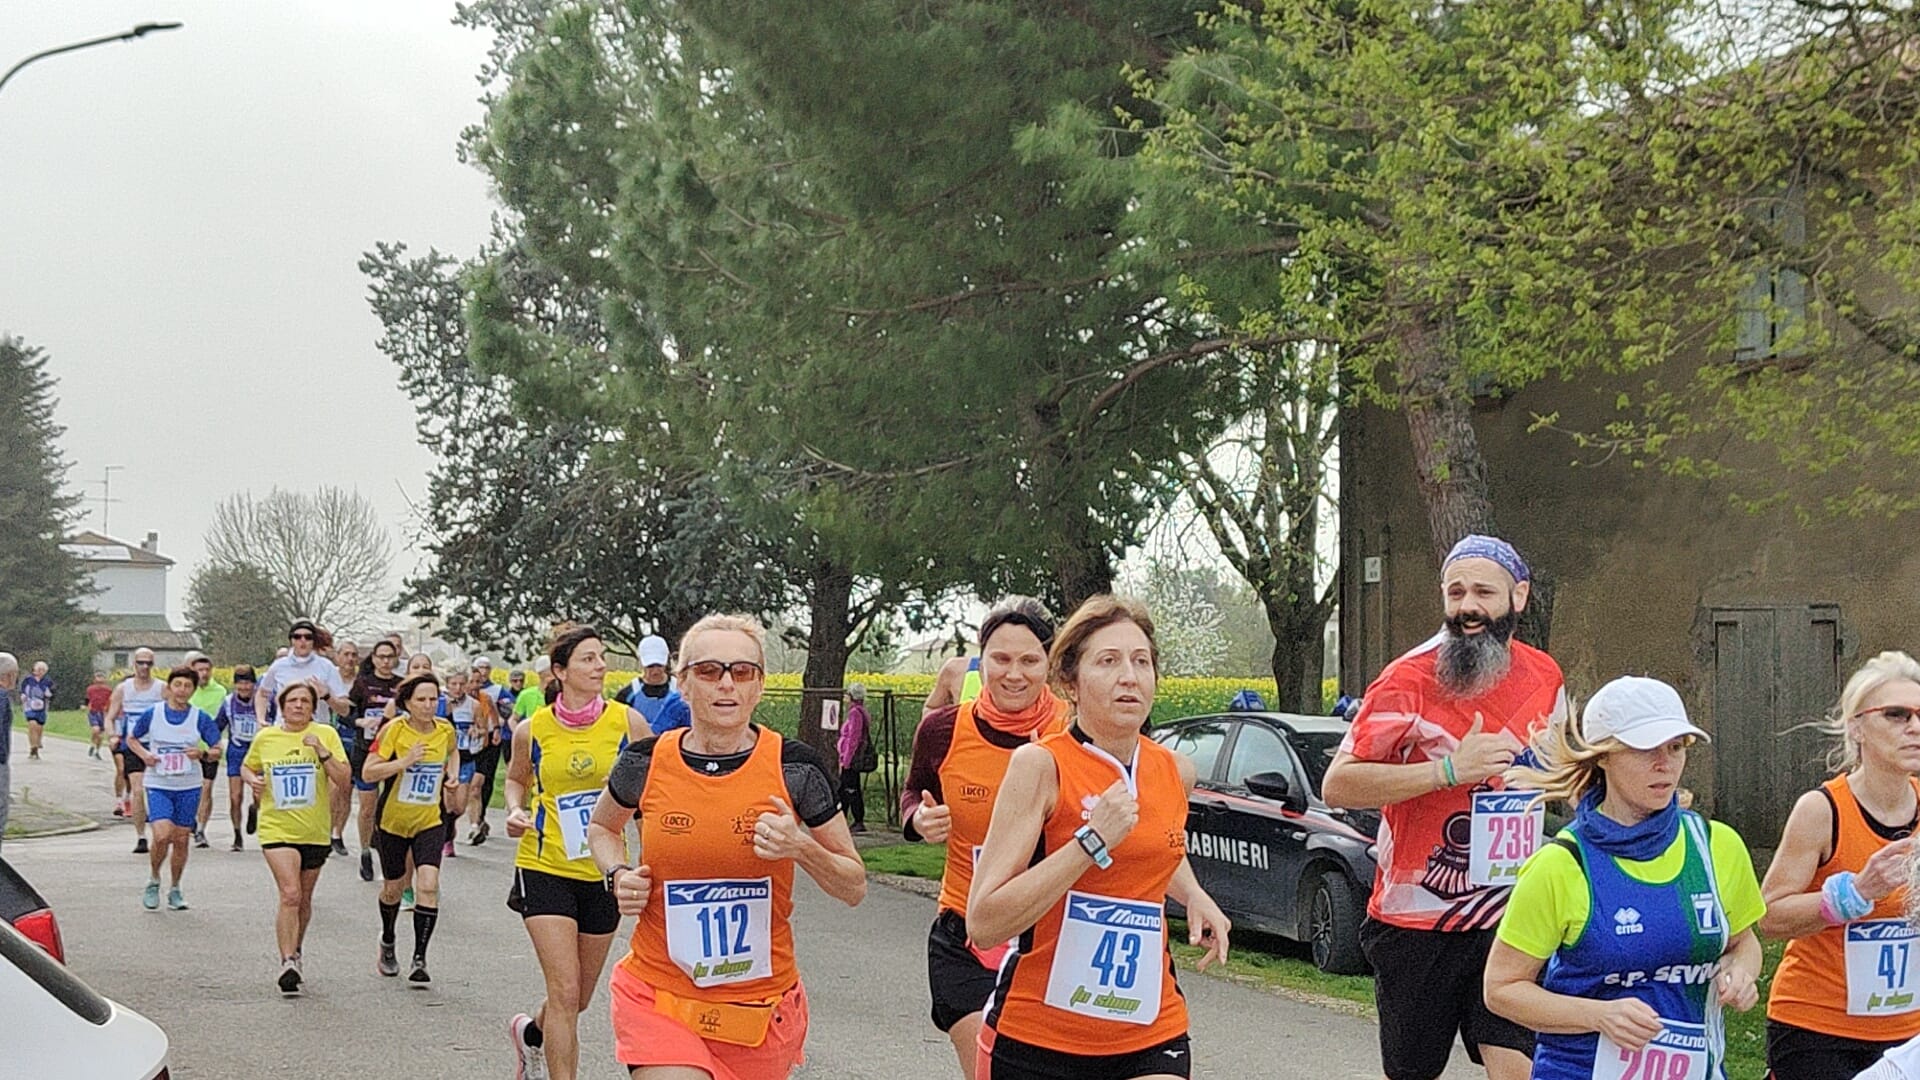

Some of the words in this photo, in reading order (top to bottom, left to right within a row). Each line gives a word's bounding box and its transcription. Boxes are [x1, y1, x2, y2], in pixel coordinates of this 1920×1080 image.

[283, 775, 307, 797] 187
[411, 774, 437, 794] 165
[1488, 815, 1535, 860] 239
[697, 903, 752, 958] 112
[1694, 900, 1714, 929] 7
[1091, 929, 1142, 989] 43
[1878, 942, 1909, 990] 47
[1619, 1047, 1691, 1080] 208
